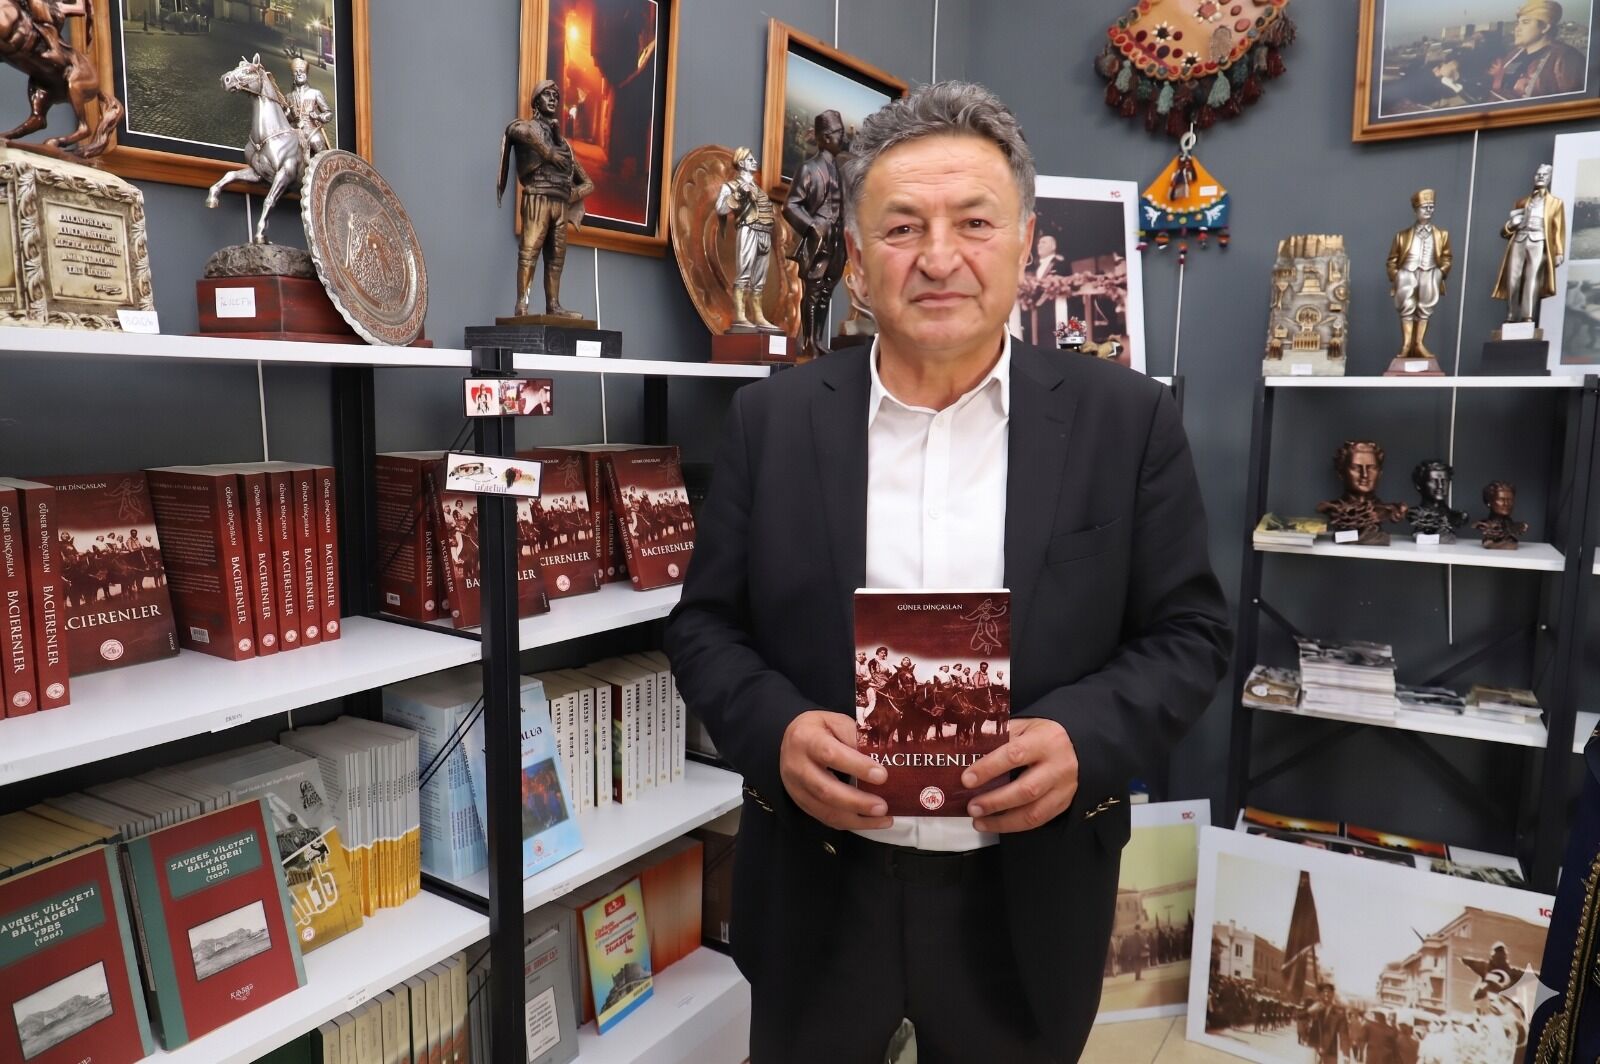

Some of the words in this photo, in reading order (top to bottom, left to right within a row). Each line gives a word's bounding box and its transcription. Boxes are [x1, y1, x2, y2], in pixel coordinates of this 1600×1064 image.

[304, 548, 315, 612] BACIERENLER
[325, 543, 335, 607] BACIERENLER
[540, 552, 591, 567] CIERENLER
[641, 541, 695, 557] BACIERENLER
[231, 557, 247, 624] BACIERENLER
[258, 553, 271, 620] BACIERENLER
[282, 551, 294, 617] BACIERENLER
[897, 603, 922, 611] GÜNER
[922, 602, 963, 611] DİNÇASLAN
[7, 590, 26, 674] BACIERENLER
[42, 586, 59, 667] BACIERENLER
[65, 604, 162, 630] CIERENLER
